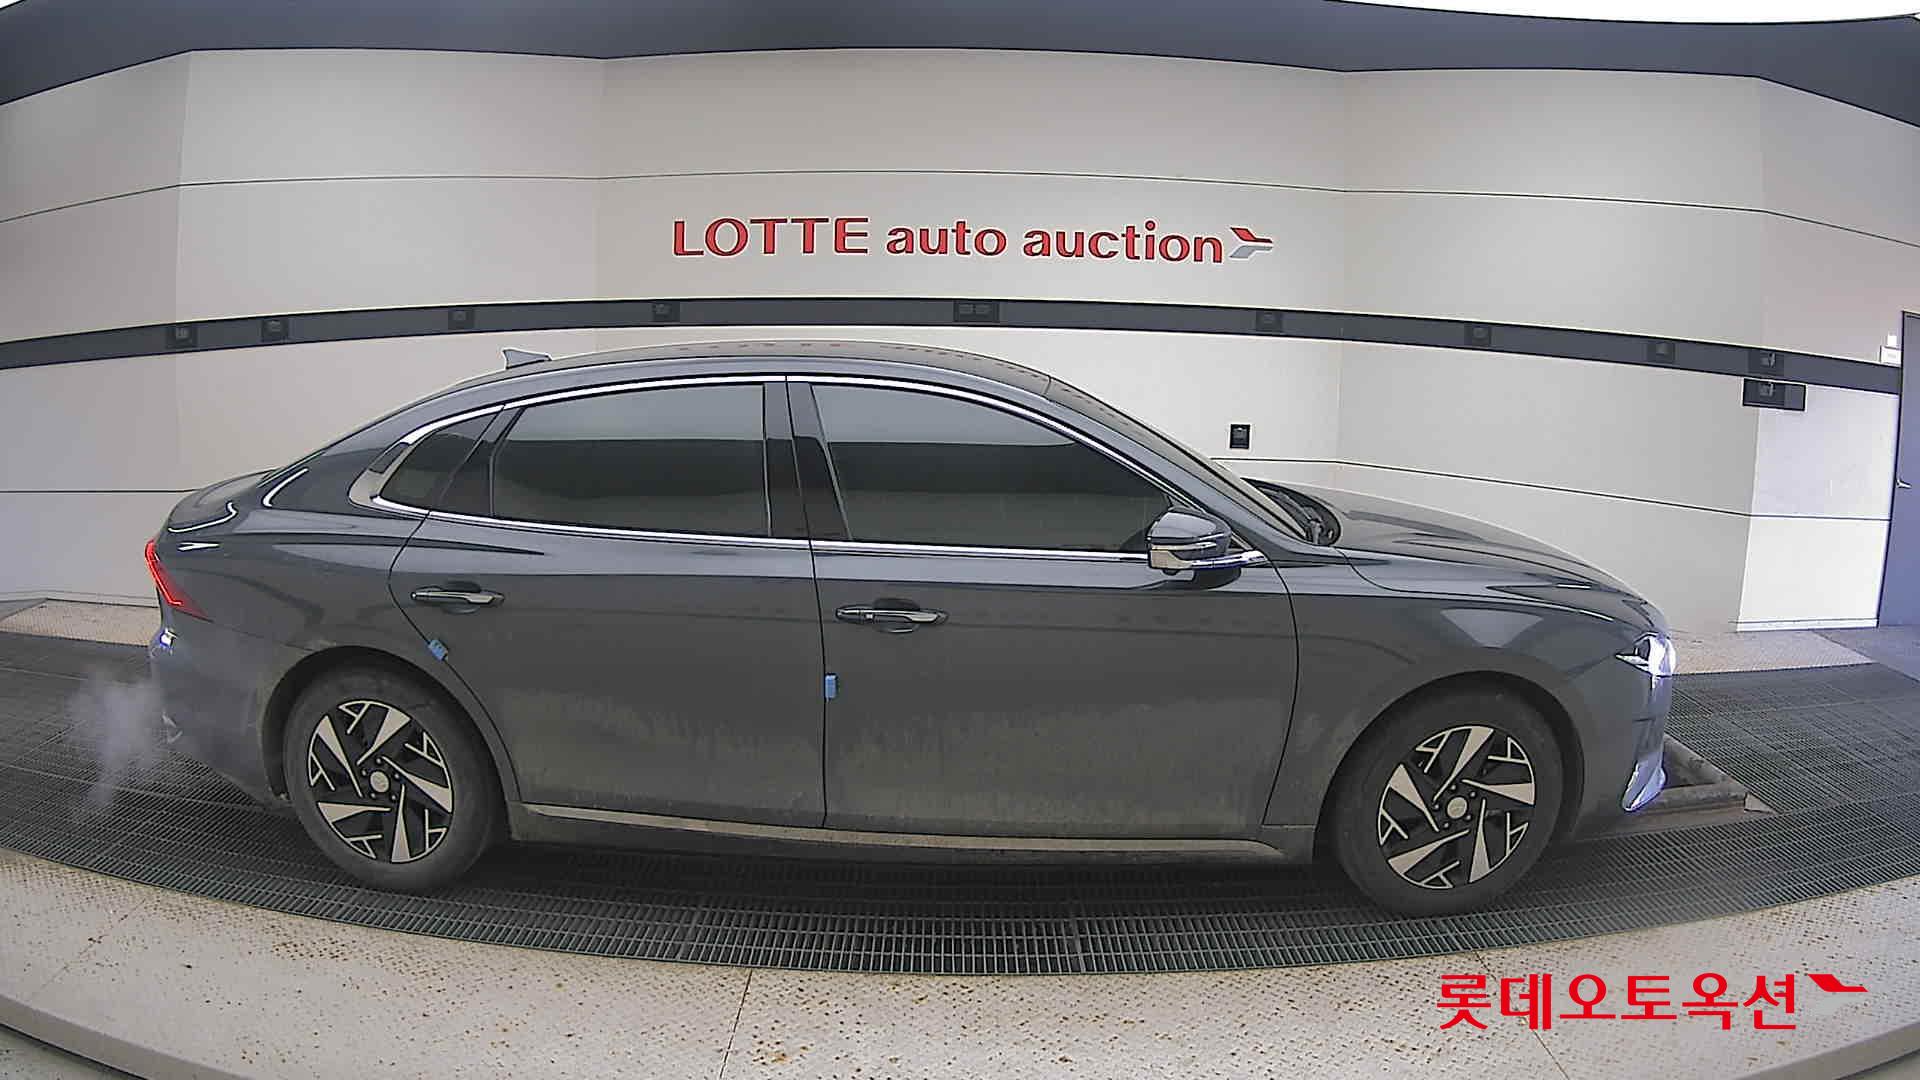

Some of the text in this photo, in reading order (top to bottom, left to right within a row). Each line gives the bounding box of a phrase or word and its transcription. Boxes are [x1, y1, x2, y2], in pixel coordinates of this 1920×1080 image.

[672, 216, 1224, 264] LOTTE auto auction
